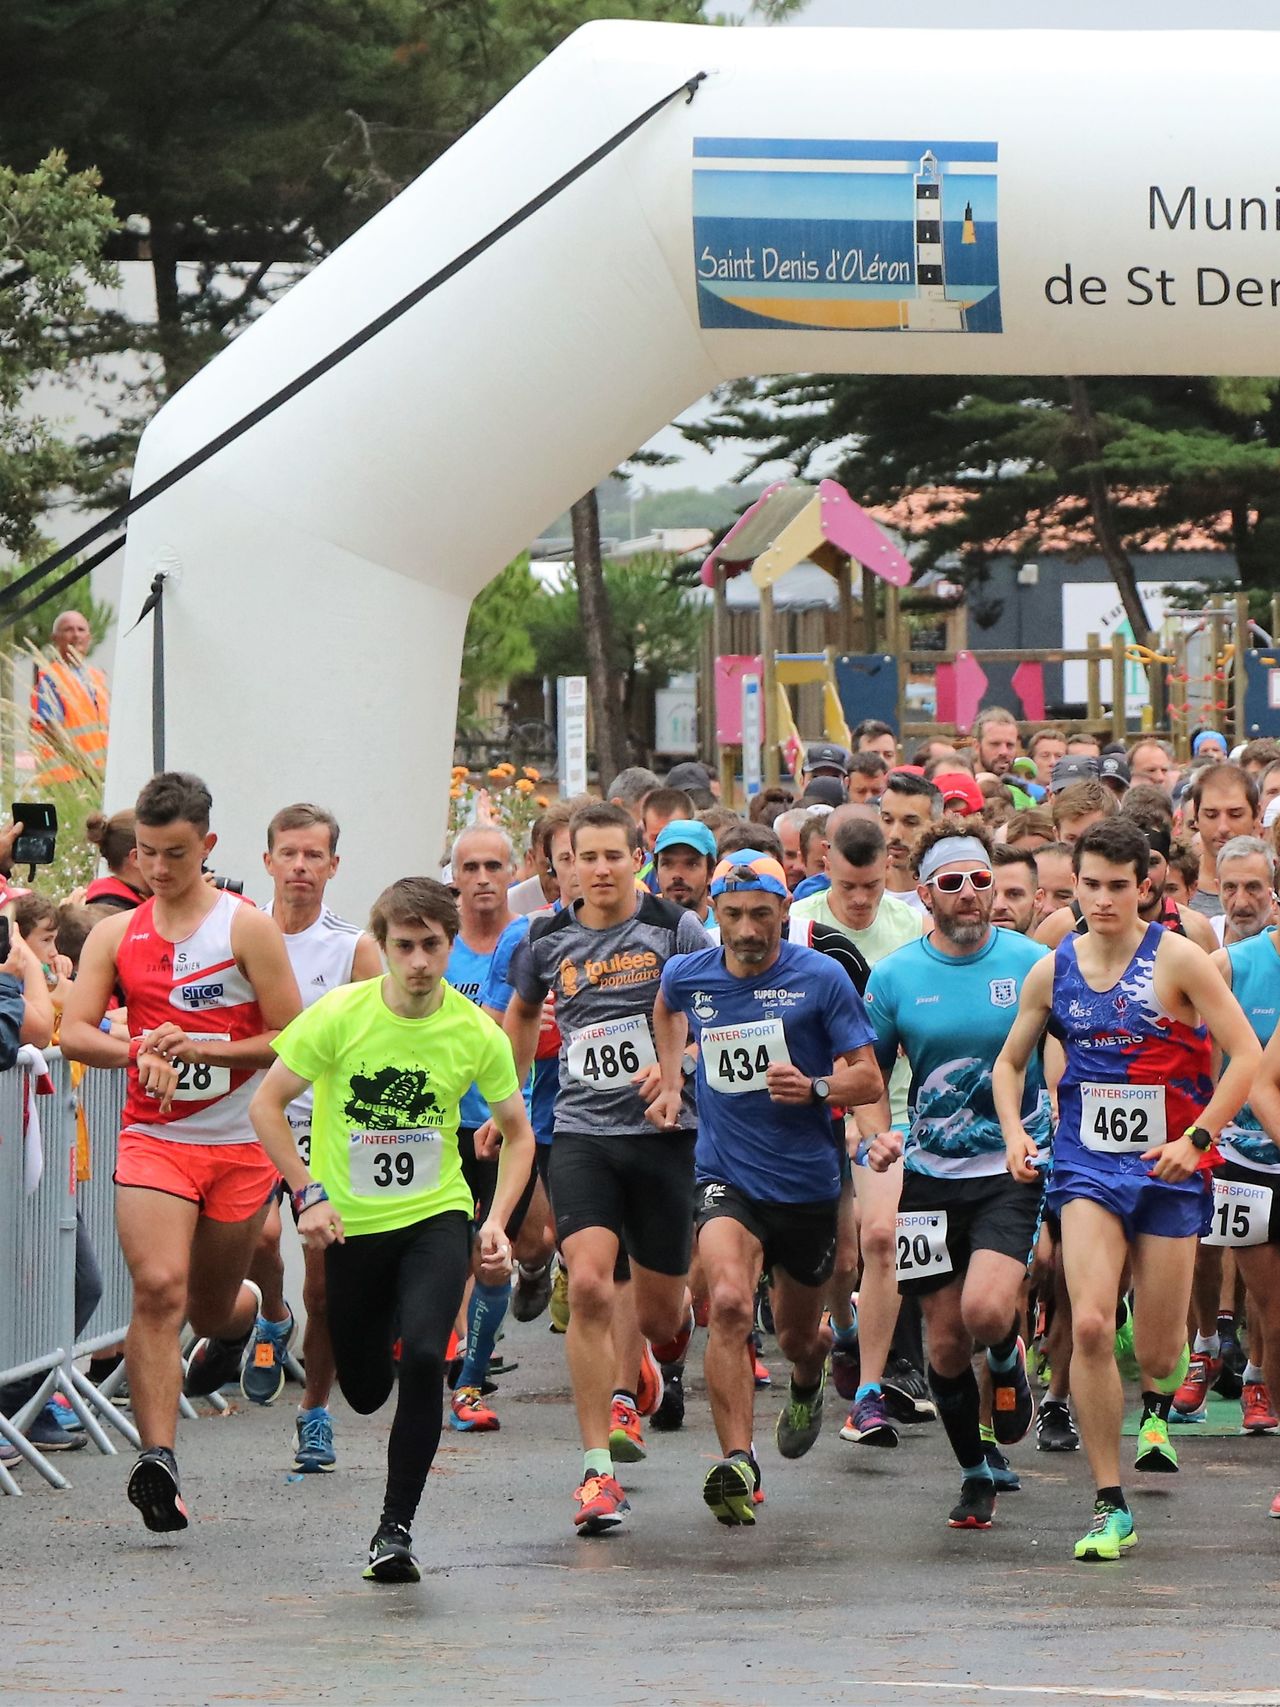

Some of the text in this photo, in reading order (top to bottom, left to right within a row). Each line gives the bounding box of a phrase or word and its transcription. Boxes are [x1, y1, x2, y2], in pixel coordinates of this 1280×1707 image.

[699, 246, 911, 282] Saint Denis d'Oléron
[1043, 263, 1108, 306] de
[1126, 265, 1176, 306] St
[584, 951, 658, 981] foulées
[183, 986, 222, 999] SITCO
[753, 989, 777, 999] SUPER
[708, 1025, 776, 1042] INTERSPORT
[1094, 1034, 1145, 1049] METRO
[583, 1041, 640, 1081] 486
[718, 1044, 772, 1083] 434
[1091, 1087, 1158, 1100] INTERSPORT
[361, 1131, 435, 1145] INTERSPORT
[1094, 1106, 1149, 1143] 462
[373, 1151, 415, 1188] 39
